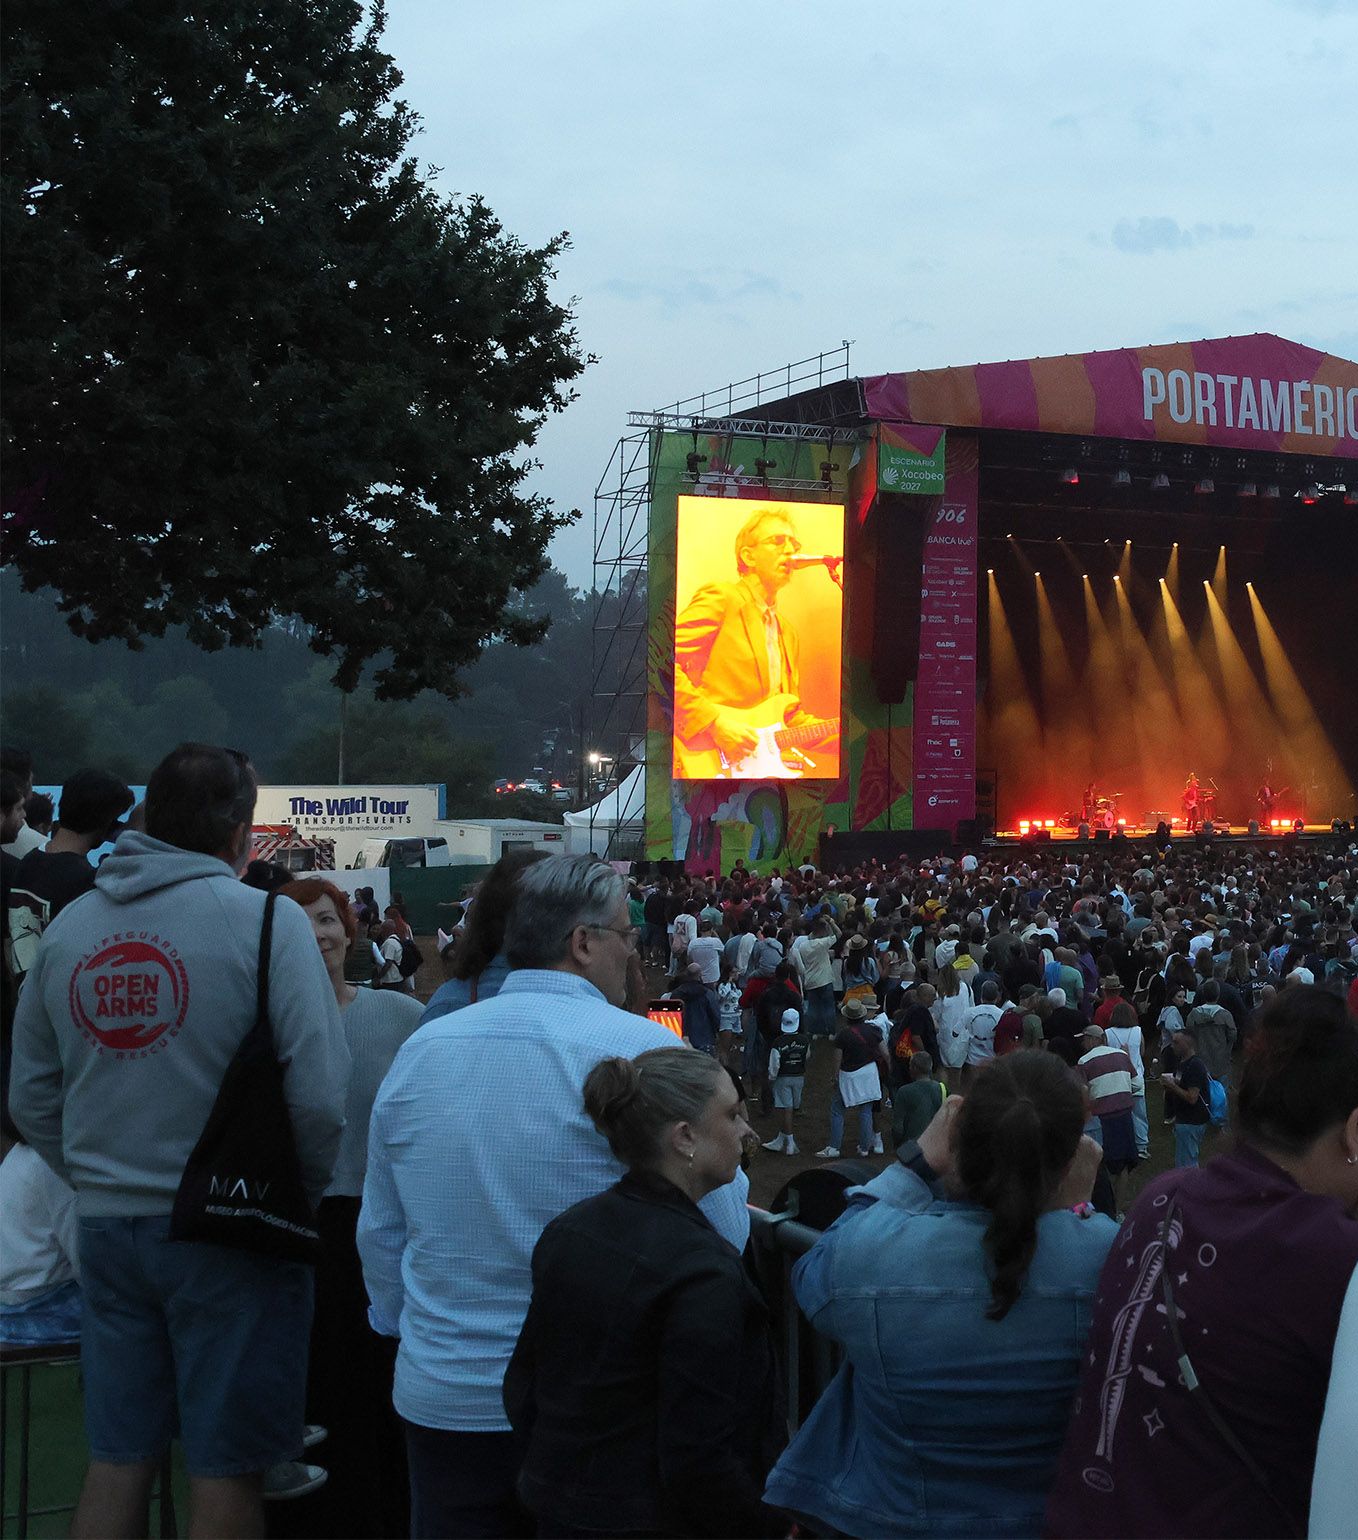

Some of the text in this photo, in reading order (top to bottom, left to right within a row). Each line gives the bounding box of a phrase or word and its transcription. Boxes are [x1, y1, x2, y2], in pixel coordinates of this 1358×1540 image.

[891, 457, 935, 467] ESCENARIO
[900, 482, 921, 491] 2027
[927, 535, 957, 545] BANCA
[289, 796, 409, 816] The Wild Tour
[94, 974, 160, 997] OPEN
[95, 997, 159, 1018] ARMS
